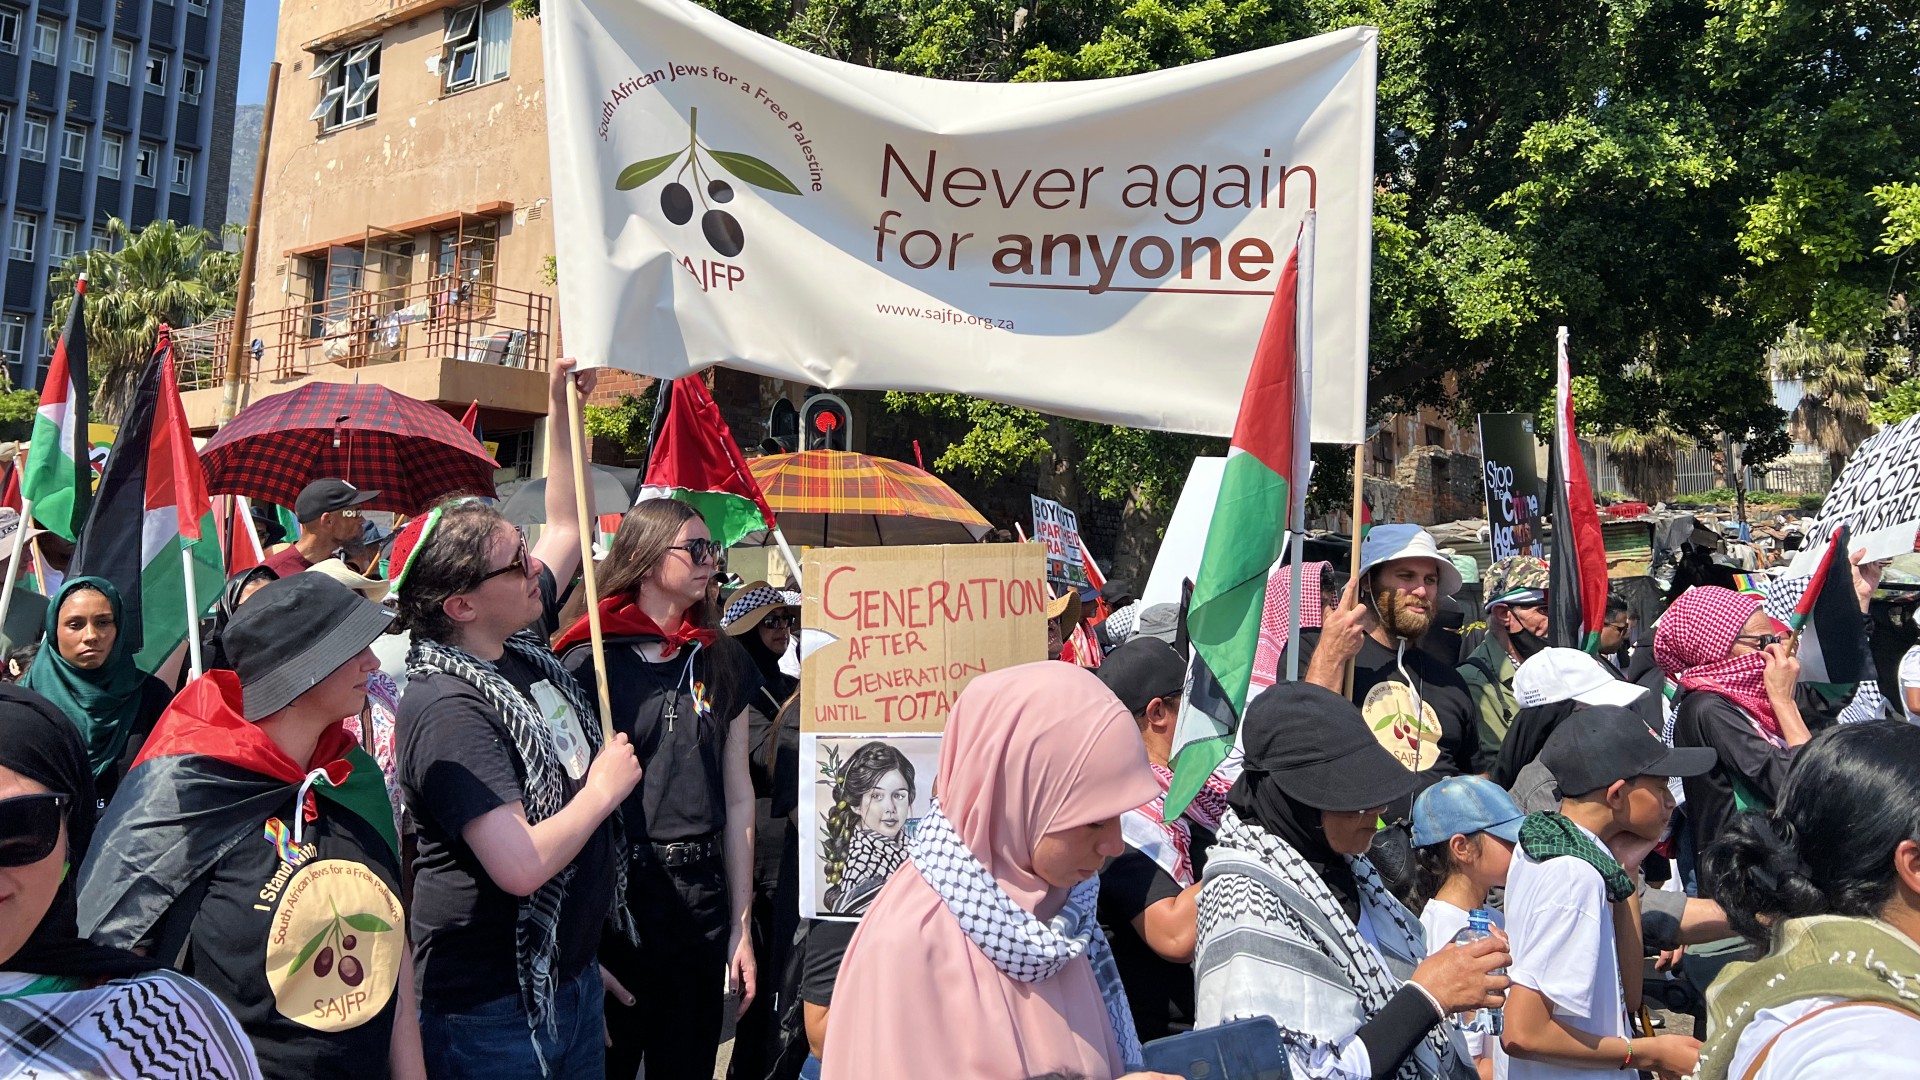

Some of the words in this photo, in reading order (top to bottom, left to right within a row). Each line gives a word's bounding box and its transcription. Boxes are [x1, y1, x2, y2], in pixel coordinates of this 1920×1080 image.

[598, 100, 617, 142] South
[610, 68, 666, 106] African
[668, 61, 708, 82] Jews
[712, 66, 738, 85] for
[740, 81, 751, 94] a
[754, 87, 789, 122] Free
[787, 121, 823, 192] Palestine
[879, 143, 1104, 210] Never
[1121, 148, 1317, 225] again
[873, 210, 974, 271] for
[990, 233, 1275, 295] anyone
[679, 256, 745, 292] AJFP
[876, 303, 1015, 331] www.sajfp.org.za
[1849, 416, 1912, 464] SOUTH
[1902, 414, 1920, 440] A
[1486, 460, 1513, 492] Stop
[1832, 452, 1882, 492] STOP
[1876, 435, 1920, 475] FUEL
[1033, 498, 1076, 531] BOYCOTT
[1501, 490, 1539, 525] Crime
[1036, 520, 1080, 547] APARTHEID
[1798, 507, 1869, 553] SANCON
[823, 566, 1044, 631] GENERATION
[849, 631, 927, 662] AFTER
[833, 658, 986, 698] GENERATION
[815, 704, 867, 722] UNTIL
[290, 842, 318, 867] with
[259, 862, 293, 903] Stand
[253, 903, 271, 912] I
[273, 909, 292, 945] South
[289, 875, 310, 910] African
[309, 867, 330, 882] Jews
[329, 864, 344, 875] for
[345, 867, 352, 875] a
[353, 867, 374, 884] Free
[374, 880, 401, 923] Palestine
[313, 991, 367, 1022] SAJFP
